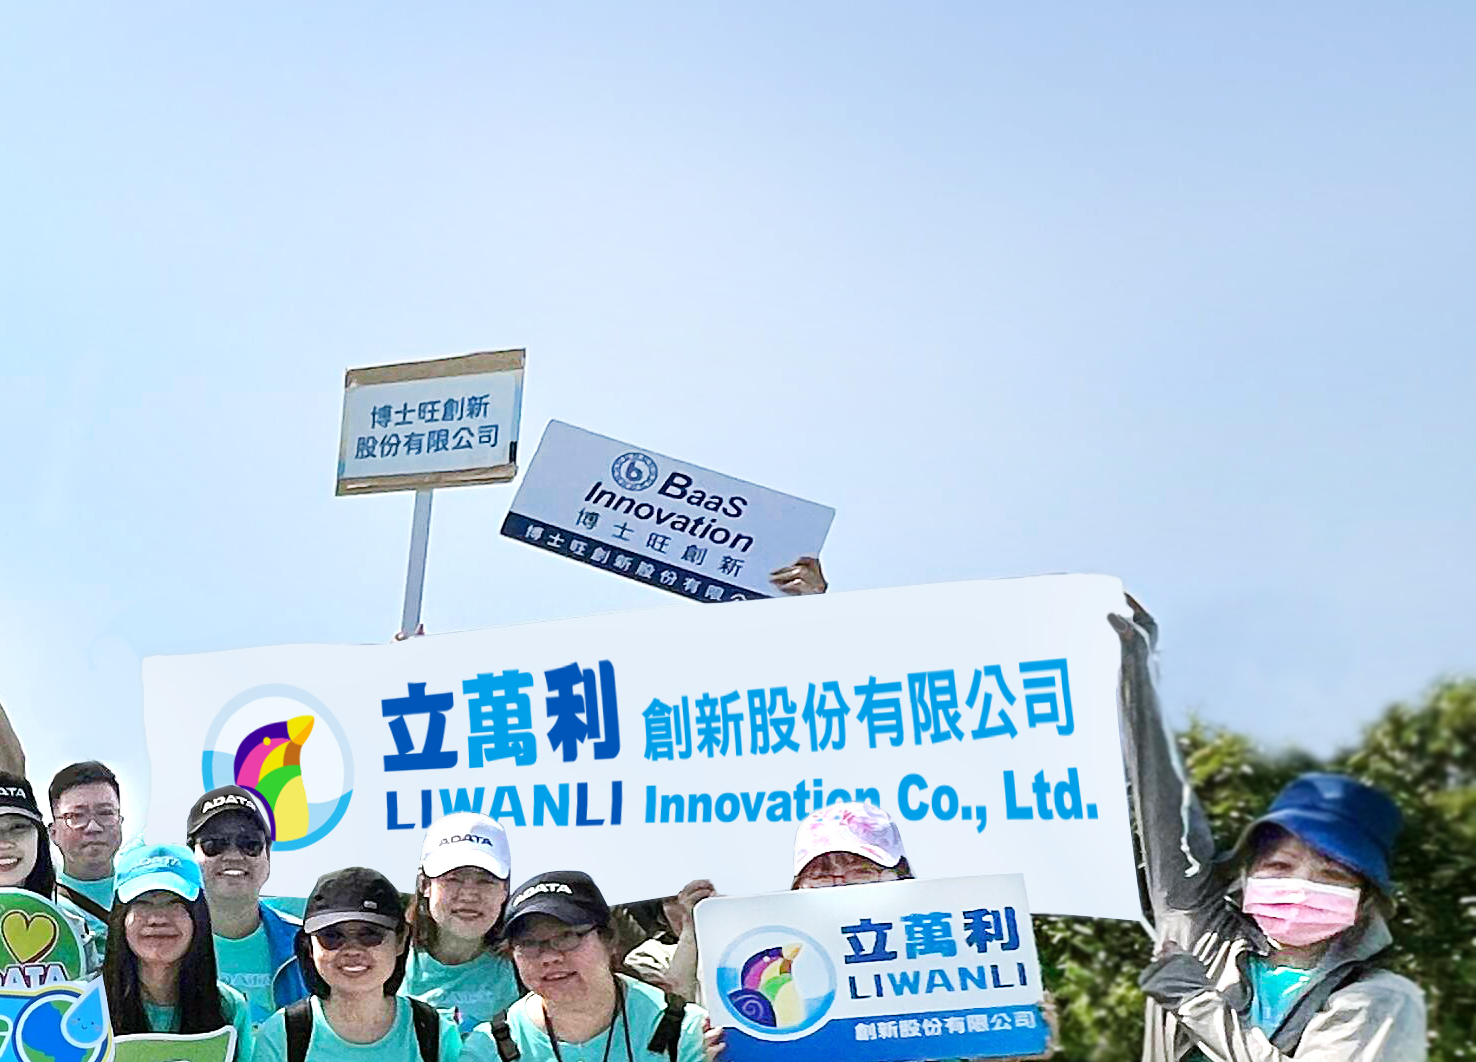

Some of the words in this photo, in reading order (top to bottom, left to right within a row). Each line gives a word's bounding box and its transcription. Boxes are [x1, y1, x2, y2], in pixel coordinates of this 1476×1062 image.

[370, 394, 491, 429] 博士旺創新
[355, 423, 499, 460] 股份有限公司
[658, 472, 748, 518] BaaS
[584, 481, 754, 552] Innovation
[575, 508, 746, 578] 博士旺創新
[381, 659, 622, 772] 立萬利
[642, 657, 1076, 762] 創新股份有限公司
[202, 794, 257, 814] ADATA
[386, 780, 623, 830] LIWANLI
[897, 773, 988, 834] Co.,
[1002, 767, 1100, 821] Ltd.
[439, 833, 494, 847] ADATA
[512, 883, 573, 907] ADATA
[840, 906, 1021, 965] 立萬利
[848, 962, 1028, 1000] LIWANLI
[854, 1010, 1038, 1042] 創新股份有限公司
